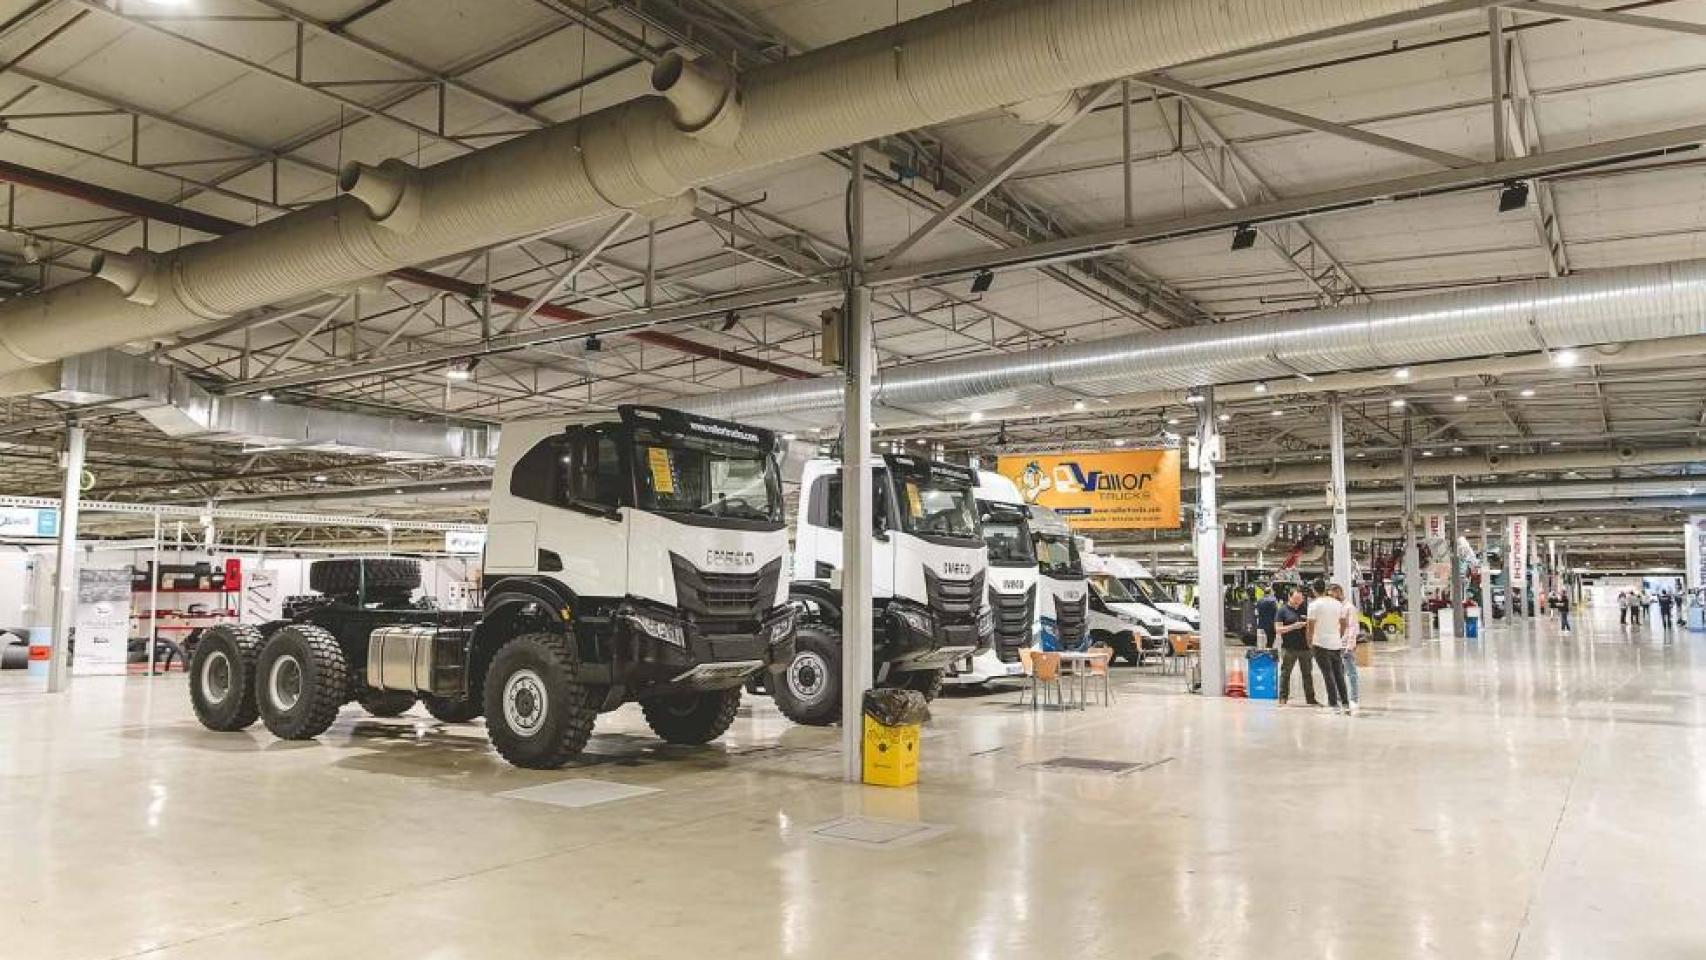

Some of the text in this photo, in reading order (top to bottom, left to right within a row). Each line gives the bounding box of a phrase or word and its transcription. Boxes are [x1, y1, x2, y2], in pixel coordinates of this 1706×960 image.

[1100, 492, 1151, 501] TRUCKS
[944, 562, 971, 575] IVECO
[1003, 579, 1025, 590] IVECO
